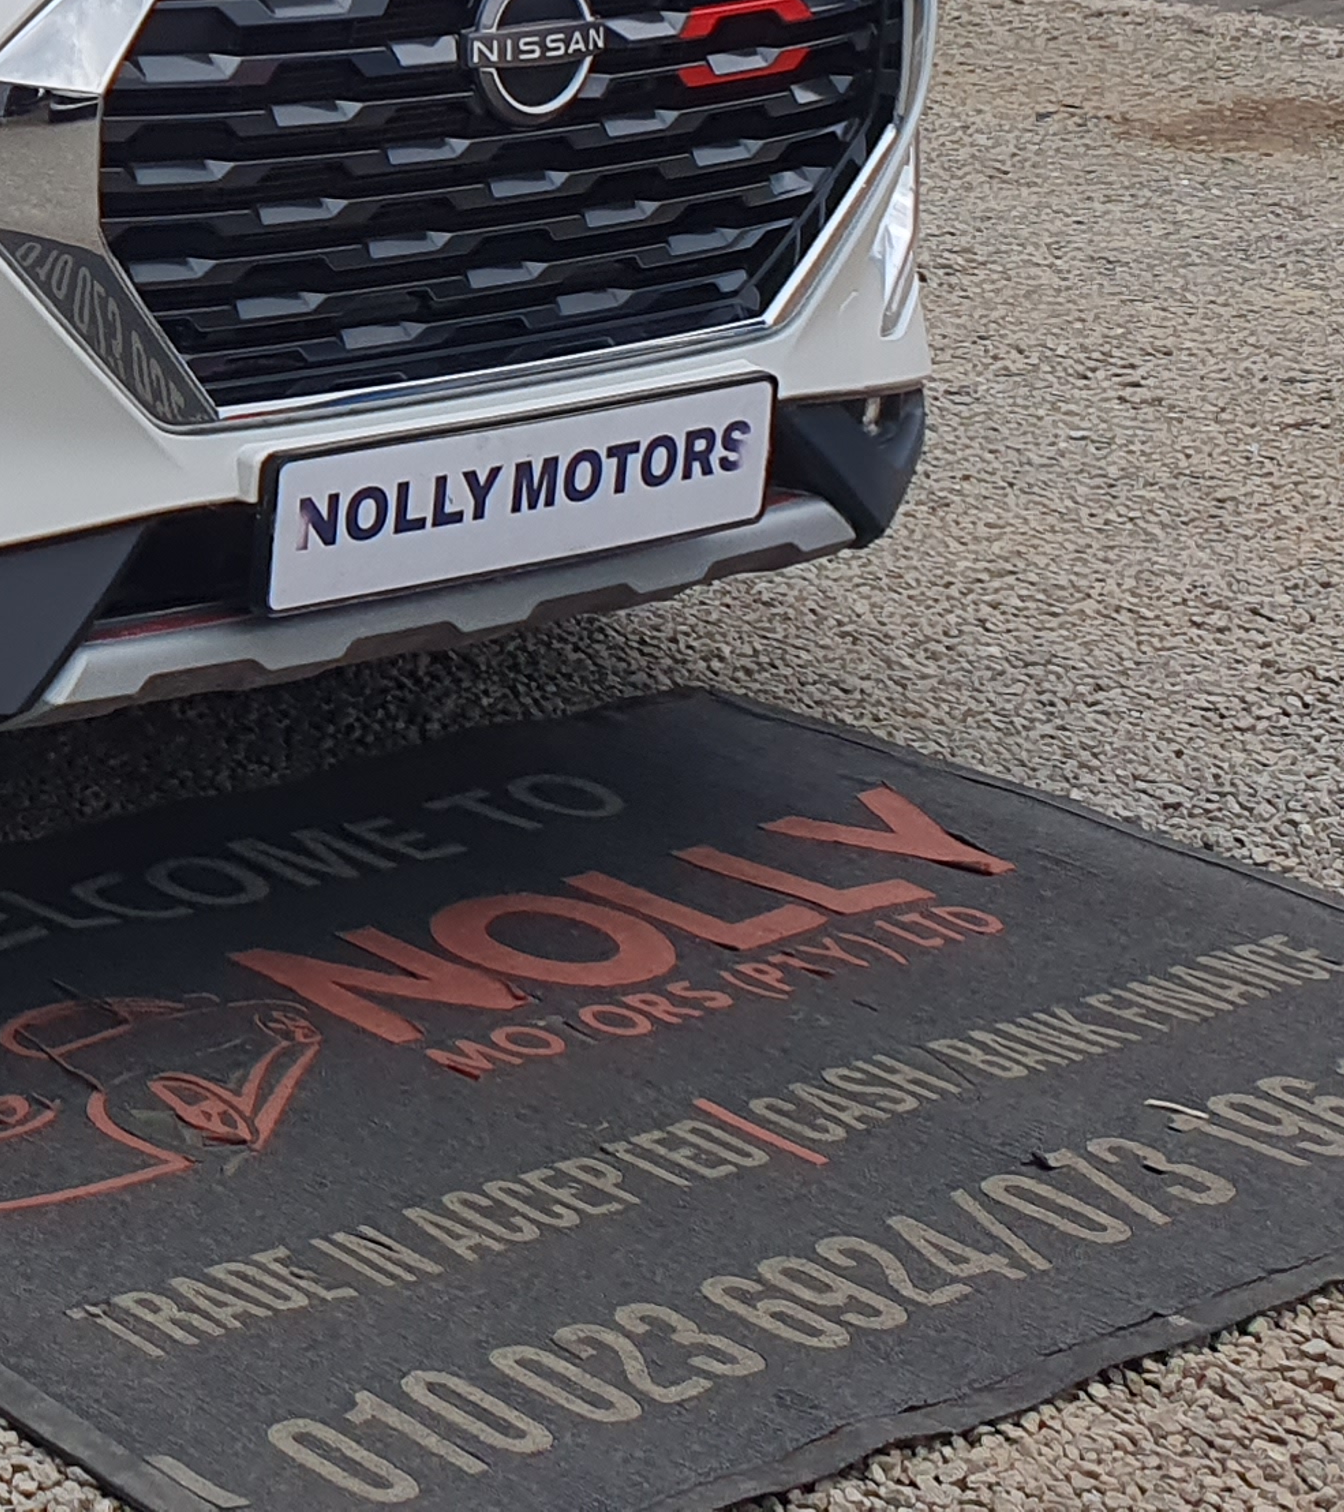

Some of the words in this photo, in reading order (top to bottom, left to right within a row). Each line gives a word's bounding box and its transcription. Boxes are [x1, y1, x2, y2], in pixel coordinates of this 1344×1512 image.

[473, 26, 605, 64] NISSAN
[295, 465, 505, 552] NOLLY
[509, 419, 752, 514] MOTORS
[427, 773, 627, 832] TO
[226, 781, 1016, 1044] NOLLY
[874, 906, 1005, 948] LTD
[64, 1245, 359, 1358] TRADE
[310, 1224, 445, 1286] IN
[402, 1118, 770, 1263] ACCEPTED
[1081, 933, 1343, 1033] FINANCE
[266, 1369, 554, 1503] 010
[488, 1301, 766, 1423] 023
